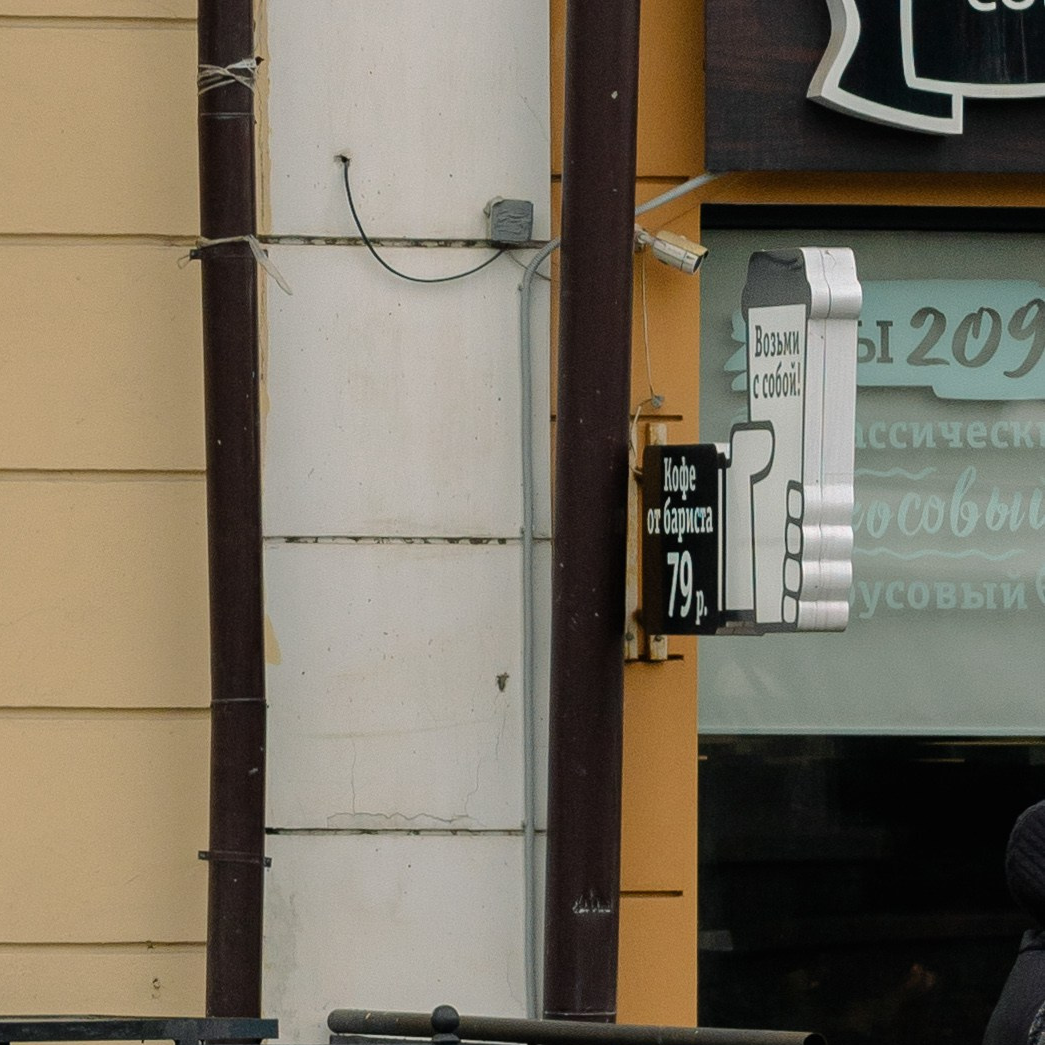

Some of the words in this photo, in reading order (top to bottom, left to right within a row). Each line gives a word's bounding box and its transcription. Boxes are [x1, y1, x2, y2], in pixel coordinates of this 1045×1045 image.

[754, 324, 800, 358] Возьми
[907, 298, 1045, 378] 209
[753, 373, 760, 399] с
[762, 361, 801, 399] собой!
[855, 420, 1045, 449] ссическ
[663, 456, 696, 500] Кофе
[647, 508, 661, 535] от
[663, 497, 714, 543] бариста
[667, 550, 693, 618] 79
[695, 589, 708, 625] р.
[849, 569, 1028, 620] усовый
